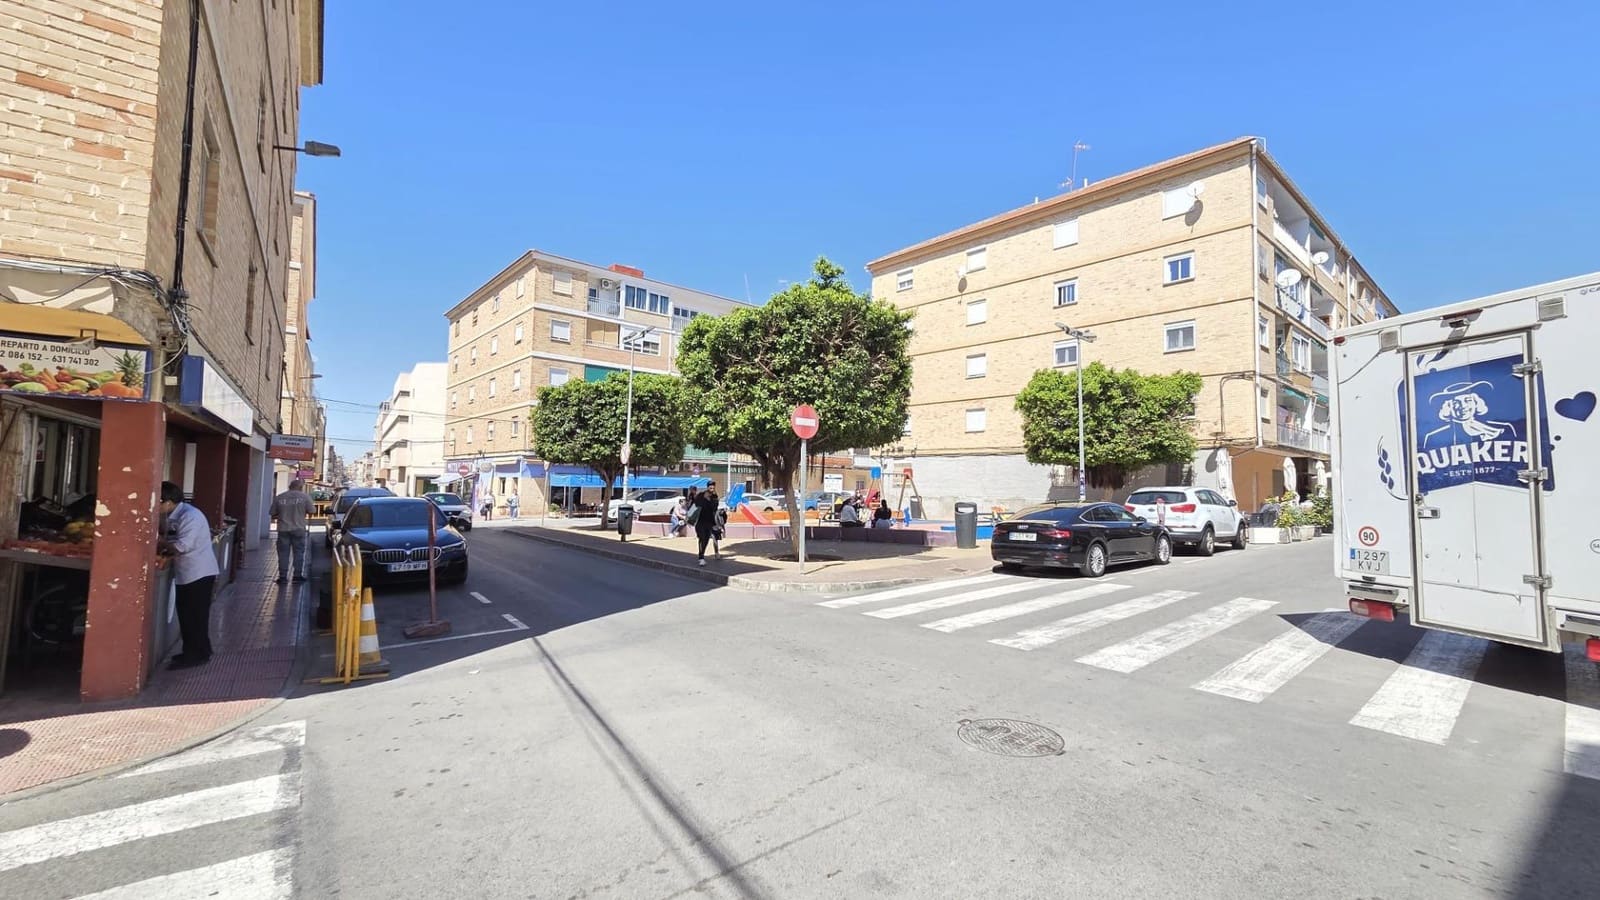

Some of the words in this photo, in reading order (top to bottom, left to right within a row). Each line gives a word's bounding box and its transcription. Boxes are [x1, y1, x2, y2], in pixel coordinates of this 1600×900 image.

[1, 340, 39, 350] REPARTO
[50, 345, 90, 355] DOMICILIO
[8, 351, 25, 359] 086
[28, 353, 42, 361] 152
[52, 355, 66, 363] 631
[84, 358, 99, 366] 302
[1417, 441, 1528, 474] QUAKER
[1475, 467, 1494, 475] 1877
[1363, 532, 1375, 541] 90
[1357, 551, 1386, 561] 1297
[1358, 561, 1381, 571] KVJ
